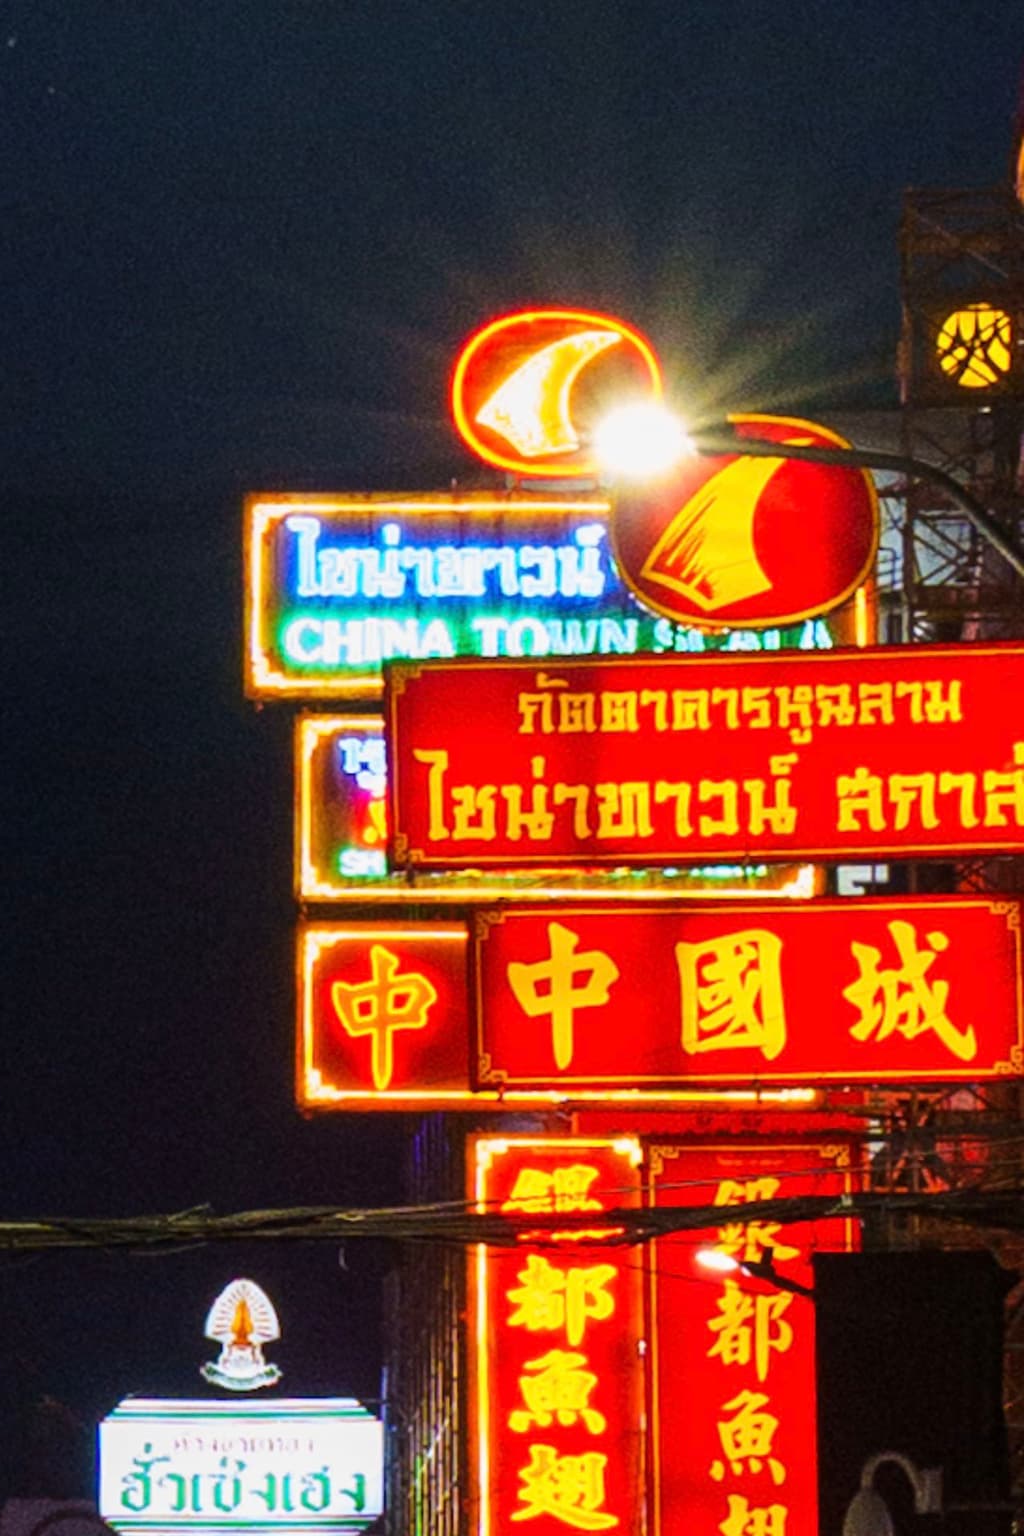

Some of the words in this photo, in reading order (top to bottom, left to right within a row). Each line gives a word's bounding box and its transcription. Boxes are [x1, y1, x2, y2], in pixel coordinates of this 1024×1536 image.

[285, 618, 456, 664] CHINA
[472, 618, 639, 657] TOWN
[413, 748, 798, 841] ไชน่าทาวน์
[331, 945, 438, 1091] 中
[505, 918, 978, 1071] 中國城
